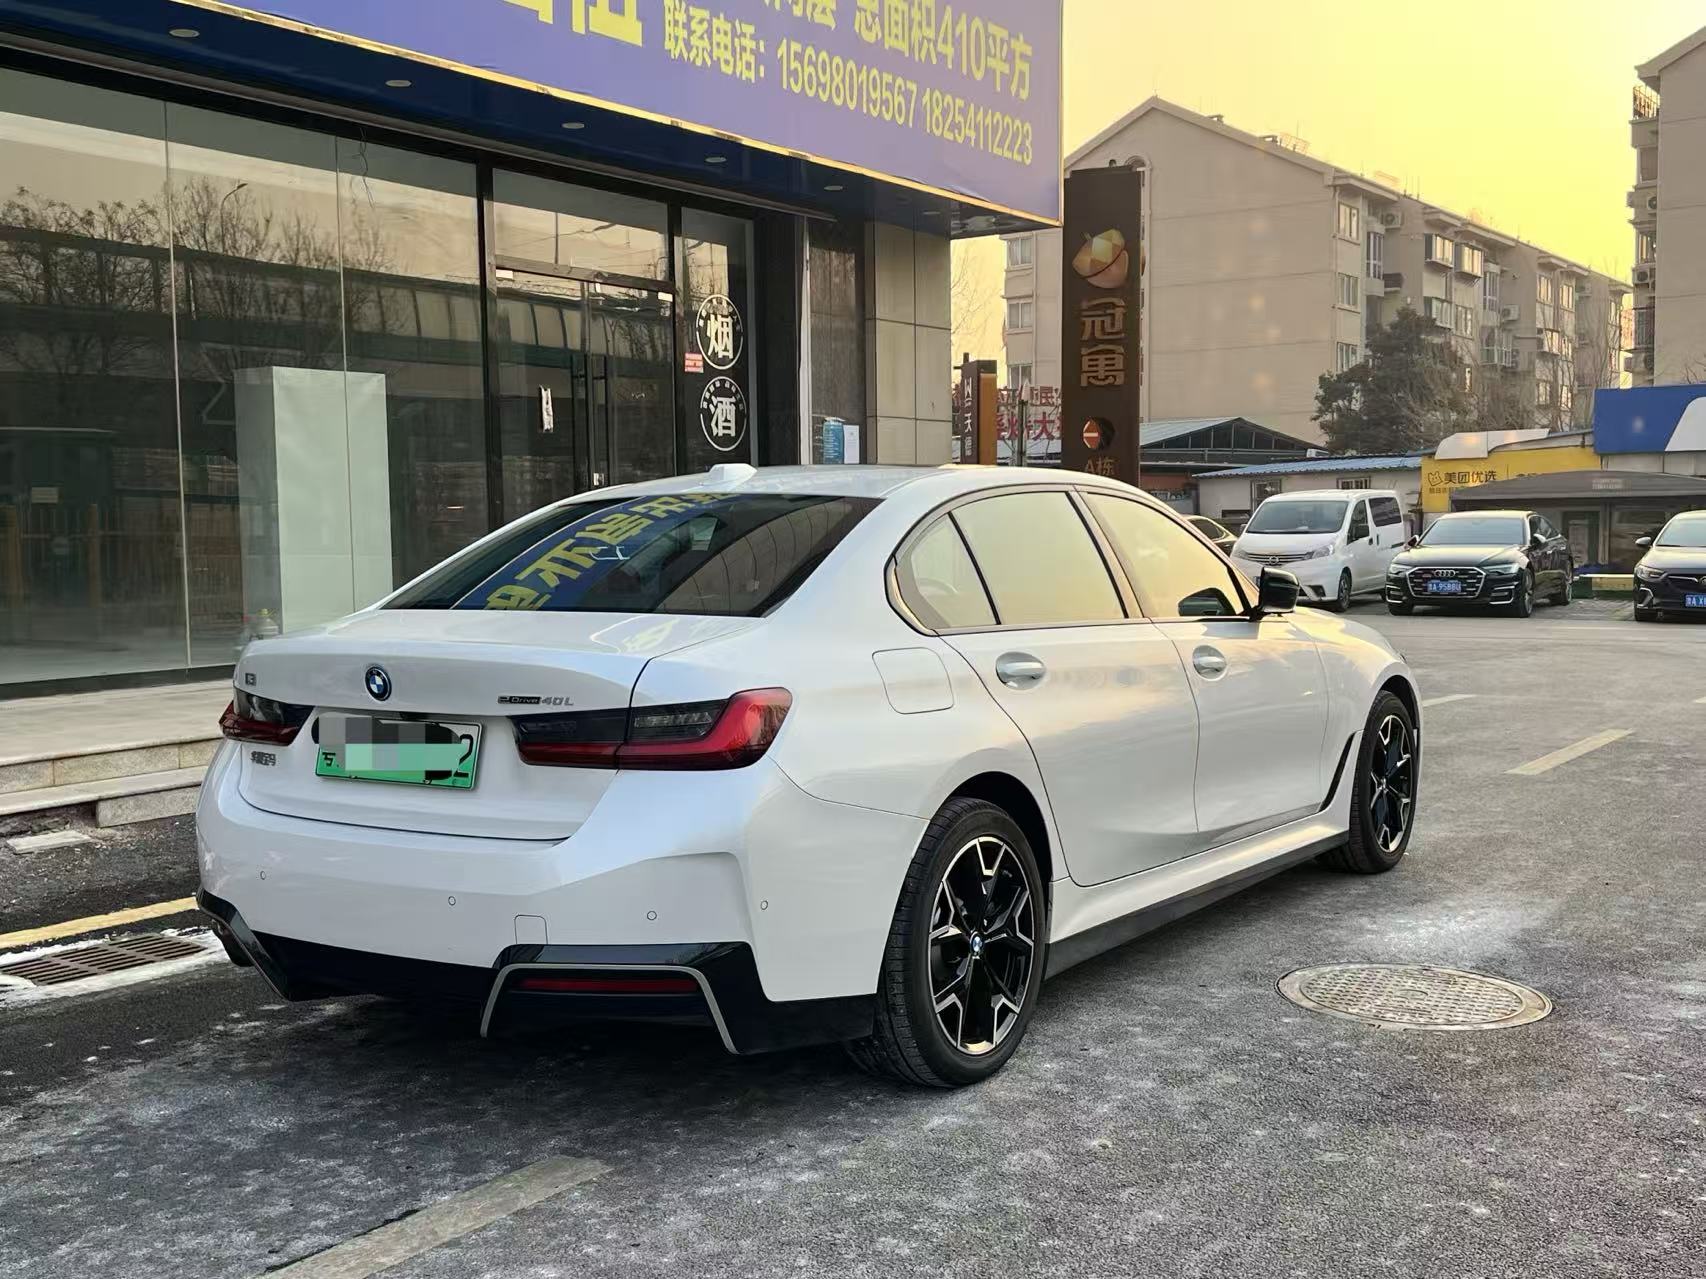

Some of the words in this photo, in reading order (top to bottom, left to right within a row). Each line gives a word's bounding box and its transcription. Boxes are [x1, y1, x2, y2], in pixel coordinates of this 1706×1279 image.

[777, 39, 917, 128] 15698019567
[921, 87, 1033, 165] 18254112223
[707, 314, 733, 359] 烟
[710, 395, 736, 437] 酒
[1444, 470, 1497, 485] 美团优选
